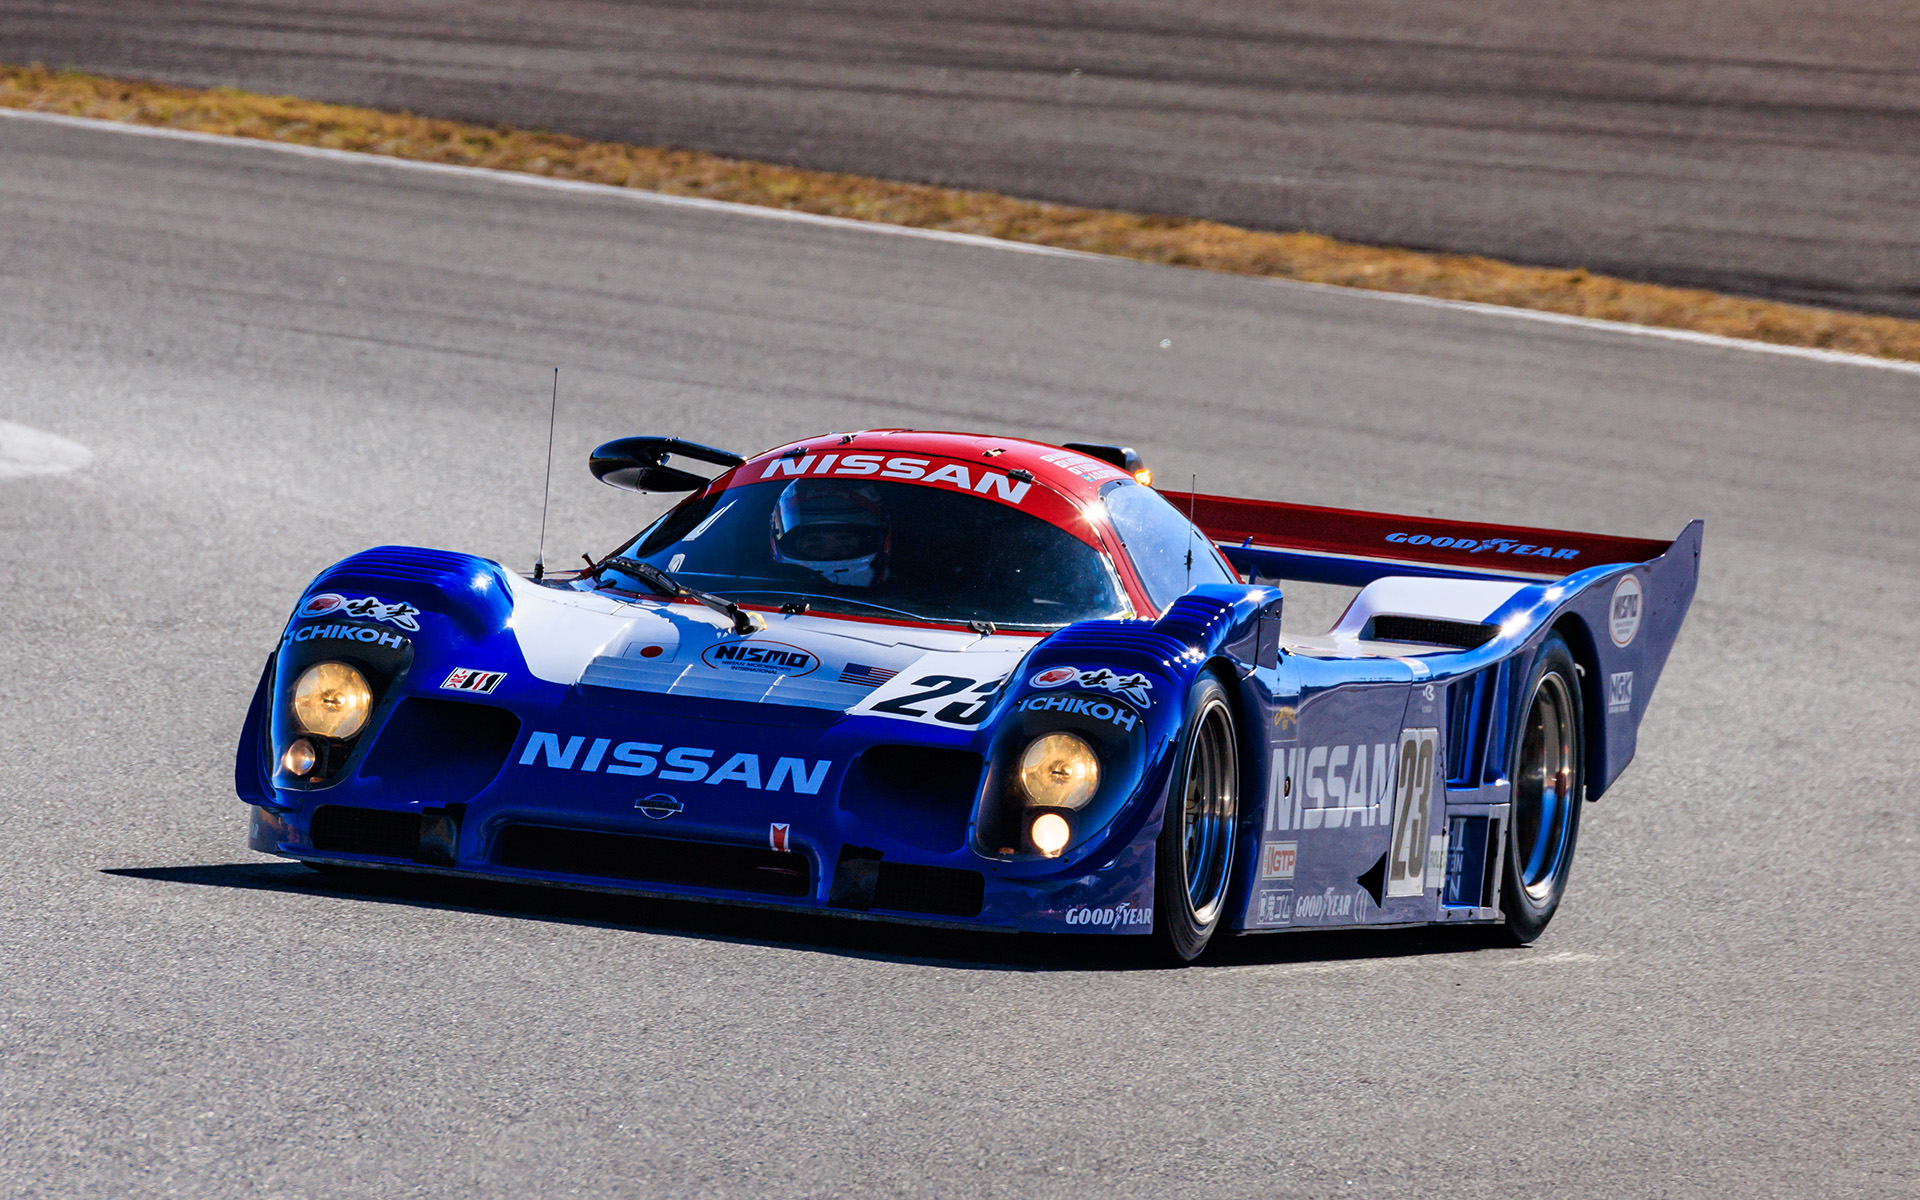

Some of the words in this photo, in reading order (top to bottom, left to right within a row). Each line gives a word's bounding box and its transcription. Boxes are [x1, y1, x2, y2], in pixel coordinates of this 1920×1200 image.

[761, 454, 1033, 504] NISSAN
[287, 625, 403, 649] ICHIKOH
[714, 645, 811, 668] NISMO
[869, 674, 1005, 725] 23
[1018, 697, 1137, 732] ICHIKOH
[519, 731, 832, 795] NISSAN
[640, 800, 678, 809] NISSAN
[1266, 743, 1399, 832] NISSAN
[1390, 738, 1433, 882] 23
[1273, 850, 1296, 872] GTP
